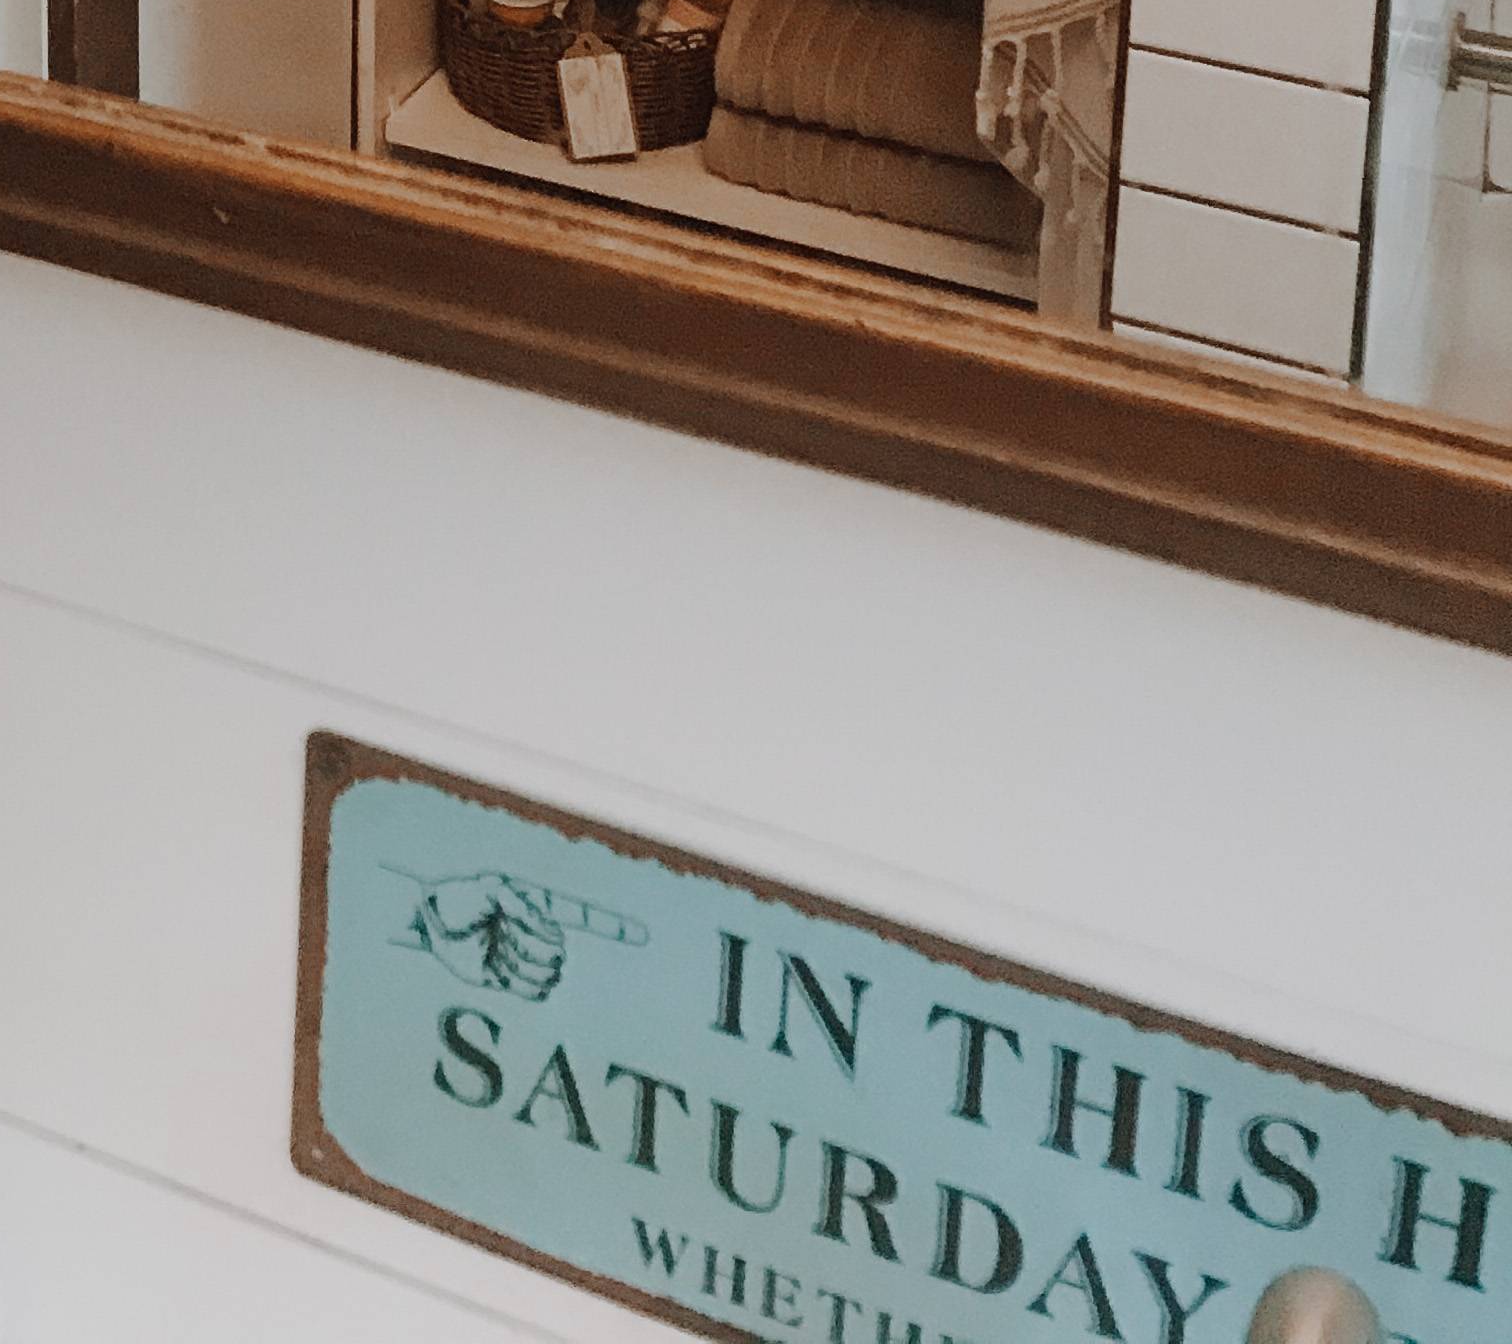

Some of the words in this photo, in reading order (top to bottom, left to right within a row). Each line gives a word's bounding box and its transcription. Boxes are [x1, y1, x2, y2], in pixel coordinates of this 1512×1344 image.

[432, 1004, 1230, 1344] SATURDAY
[708, 926, 873, 1082] IN
[926, 1002, 1321, 1233] THIS
[631, 1215, 963, 1344] WHETH
